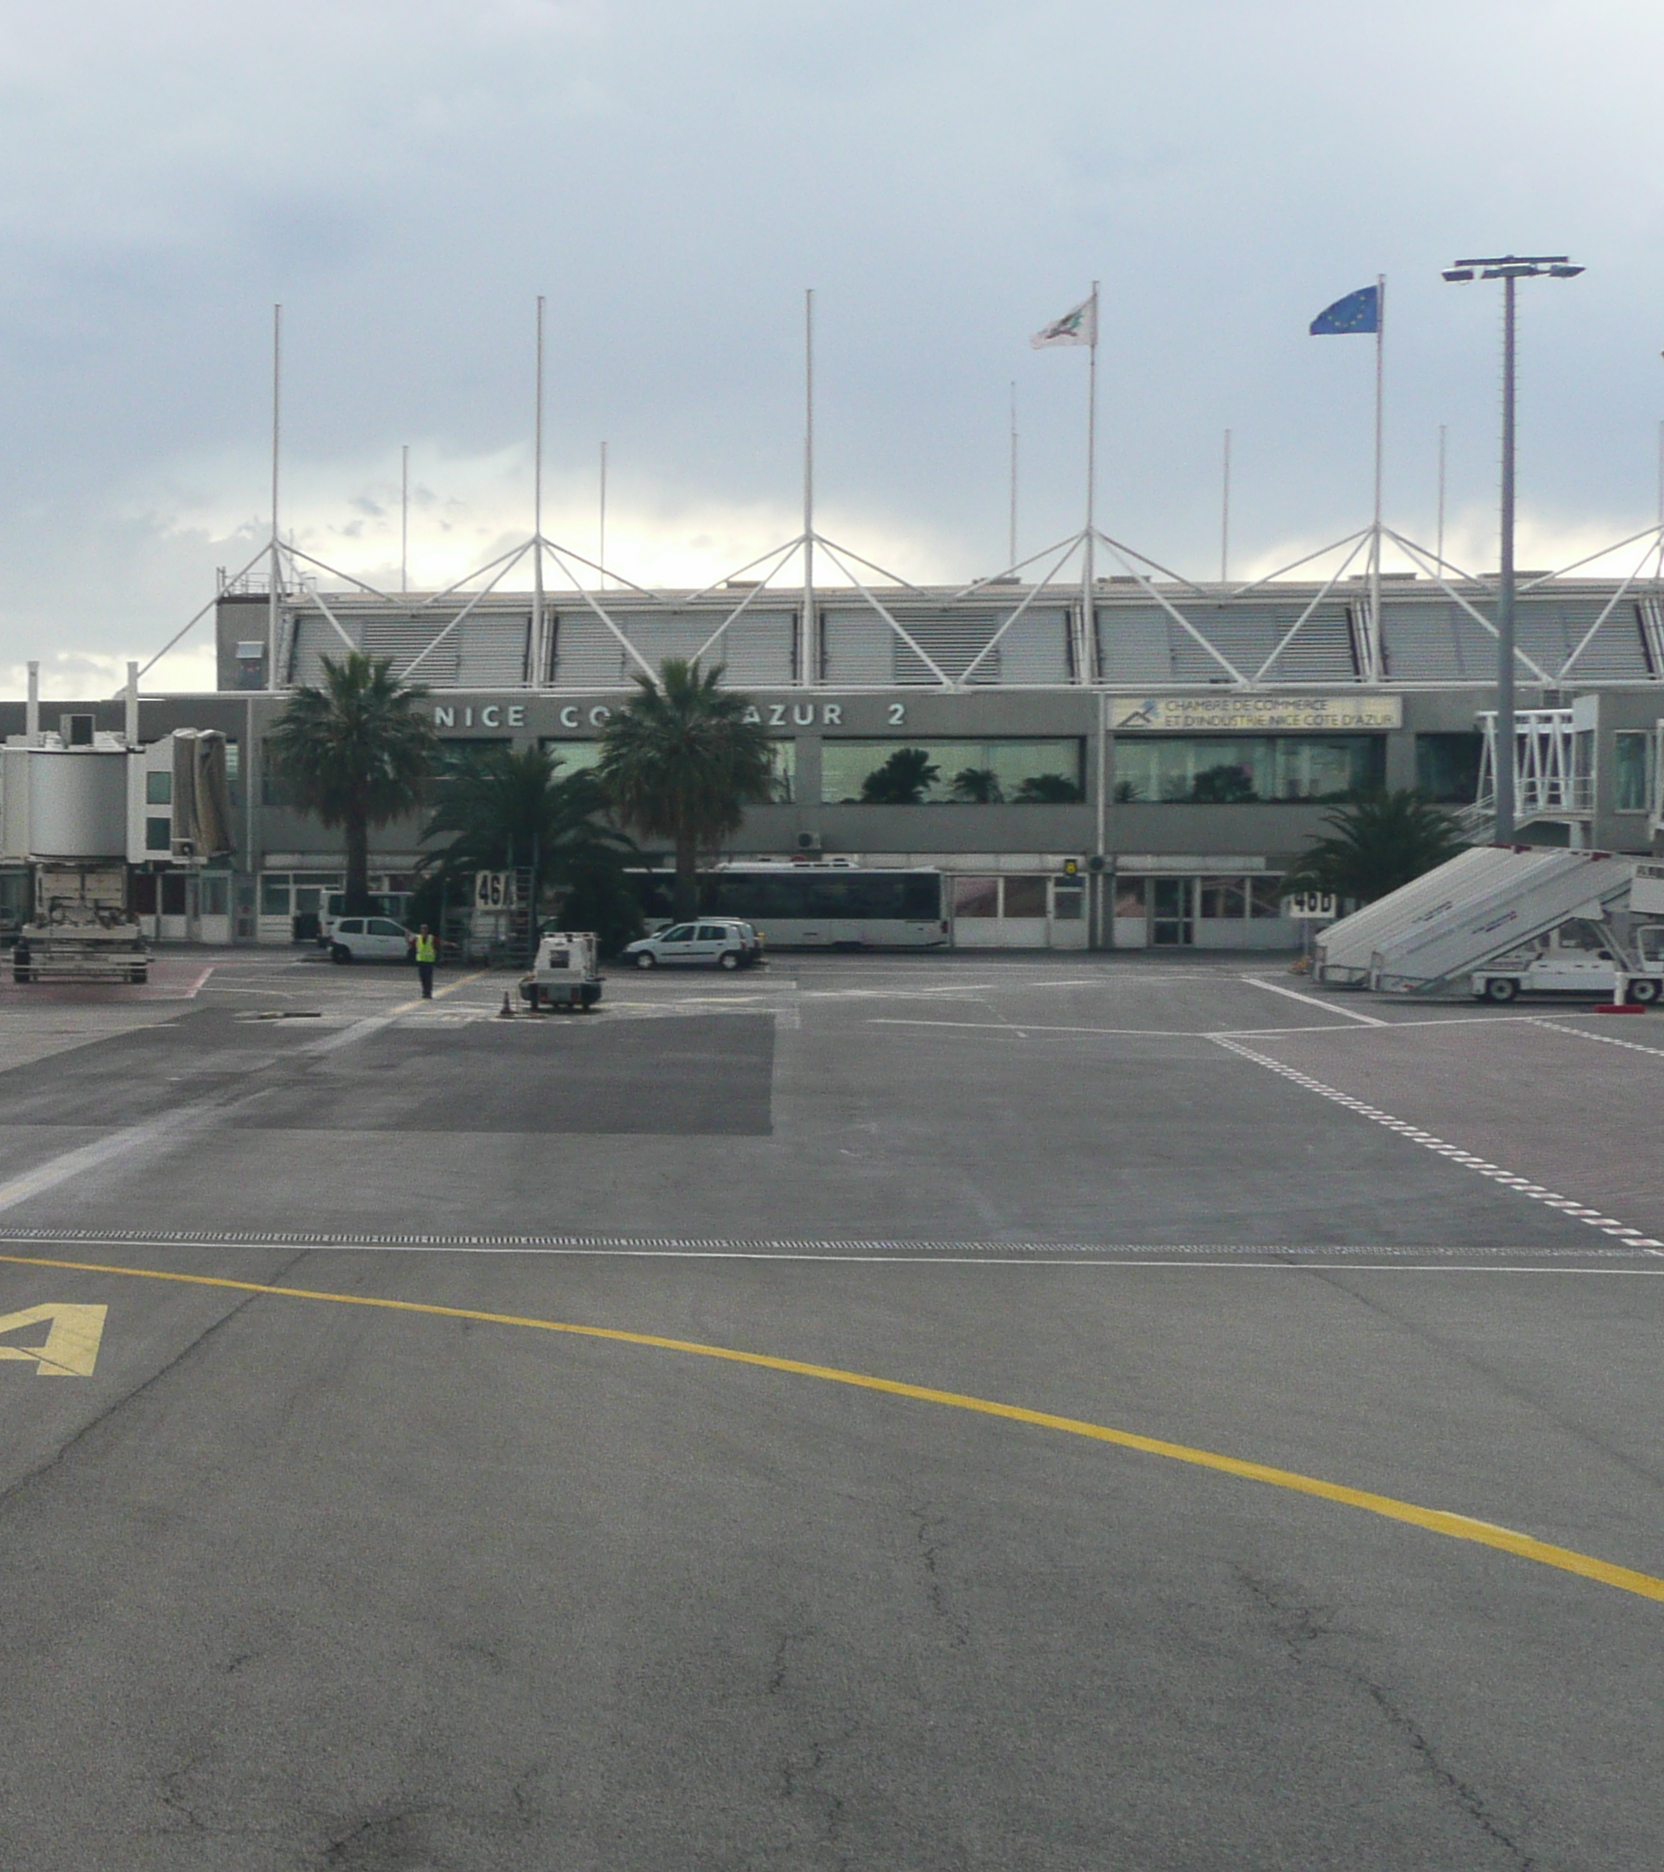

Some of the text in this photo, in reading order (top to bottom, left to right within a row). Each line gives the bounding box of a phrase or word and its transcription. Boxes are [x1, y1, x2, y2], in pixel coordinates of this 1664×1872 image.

[1165, 699, 1329, 711] CHAMBRE DE COMMERCE
[435, 703, 905, 728] NICE CO AZUR 2
[1165, 714, 1182, 727] ET
[1184, 714, 1267, 727] D'INDUSTRIE
[1268, 714, 1302, 727] NICE
[1342, 713, 1393, 726] D'AZUR
